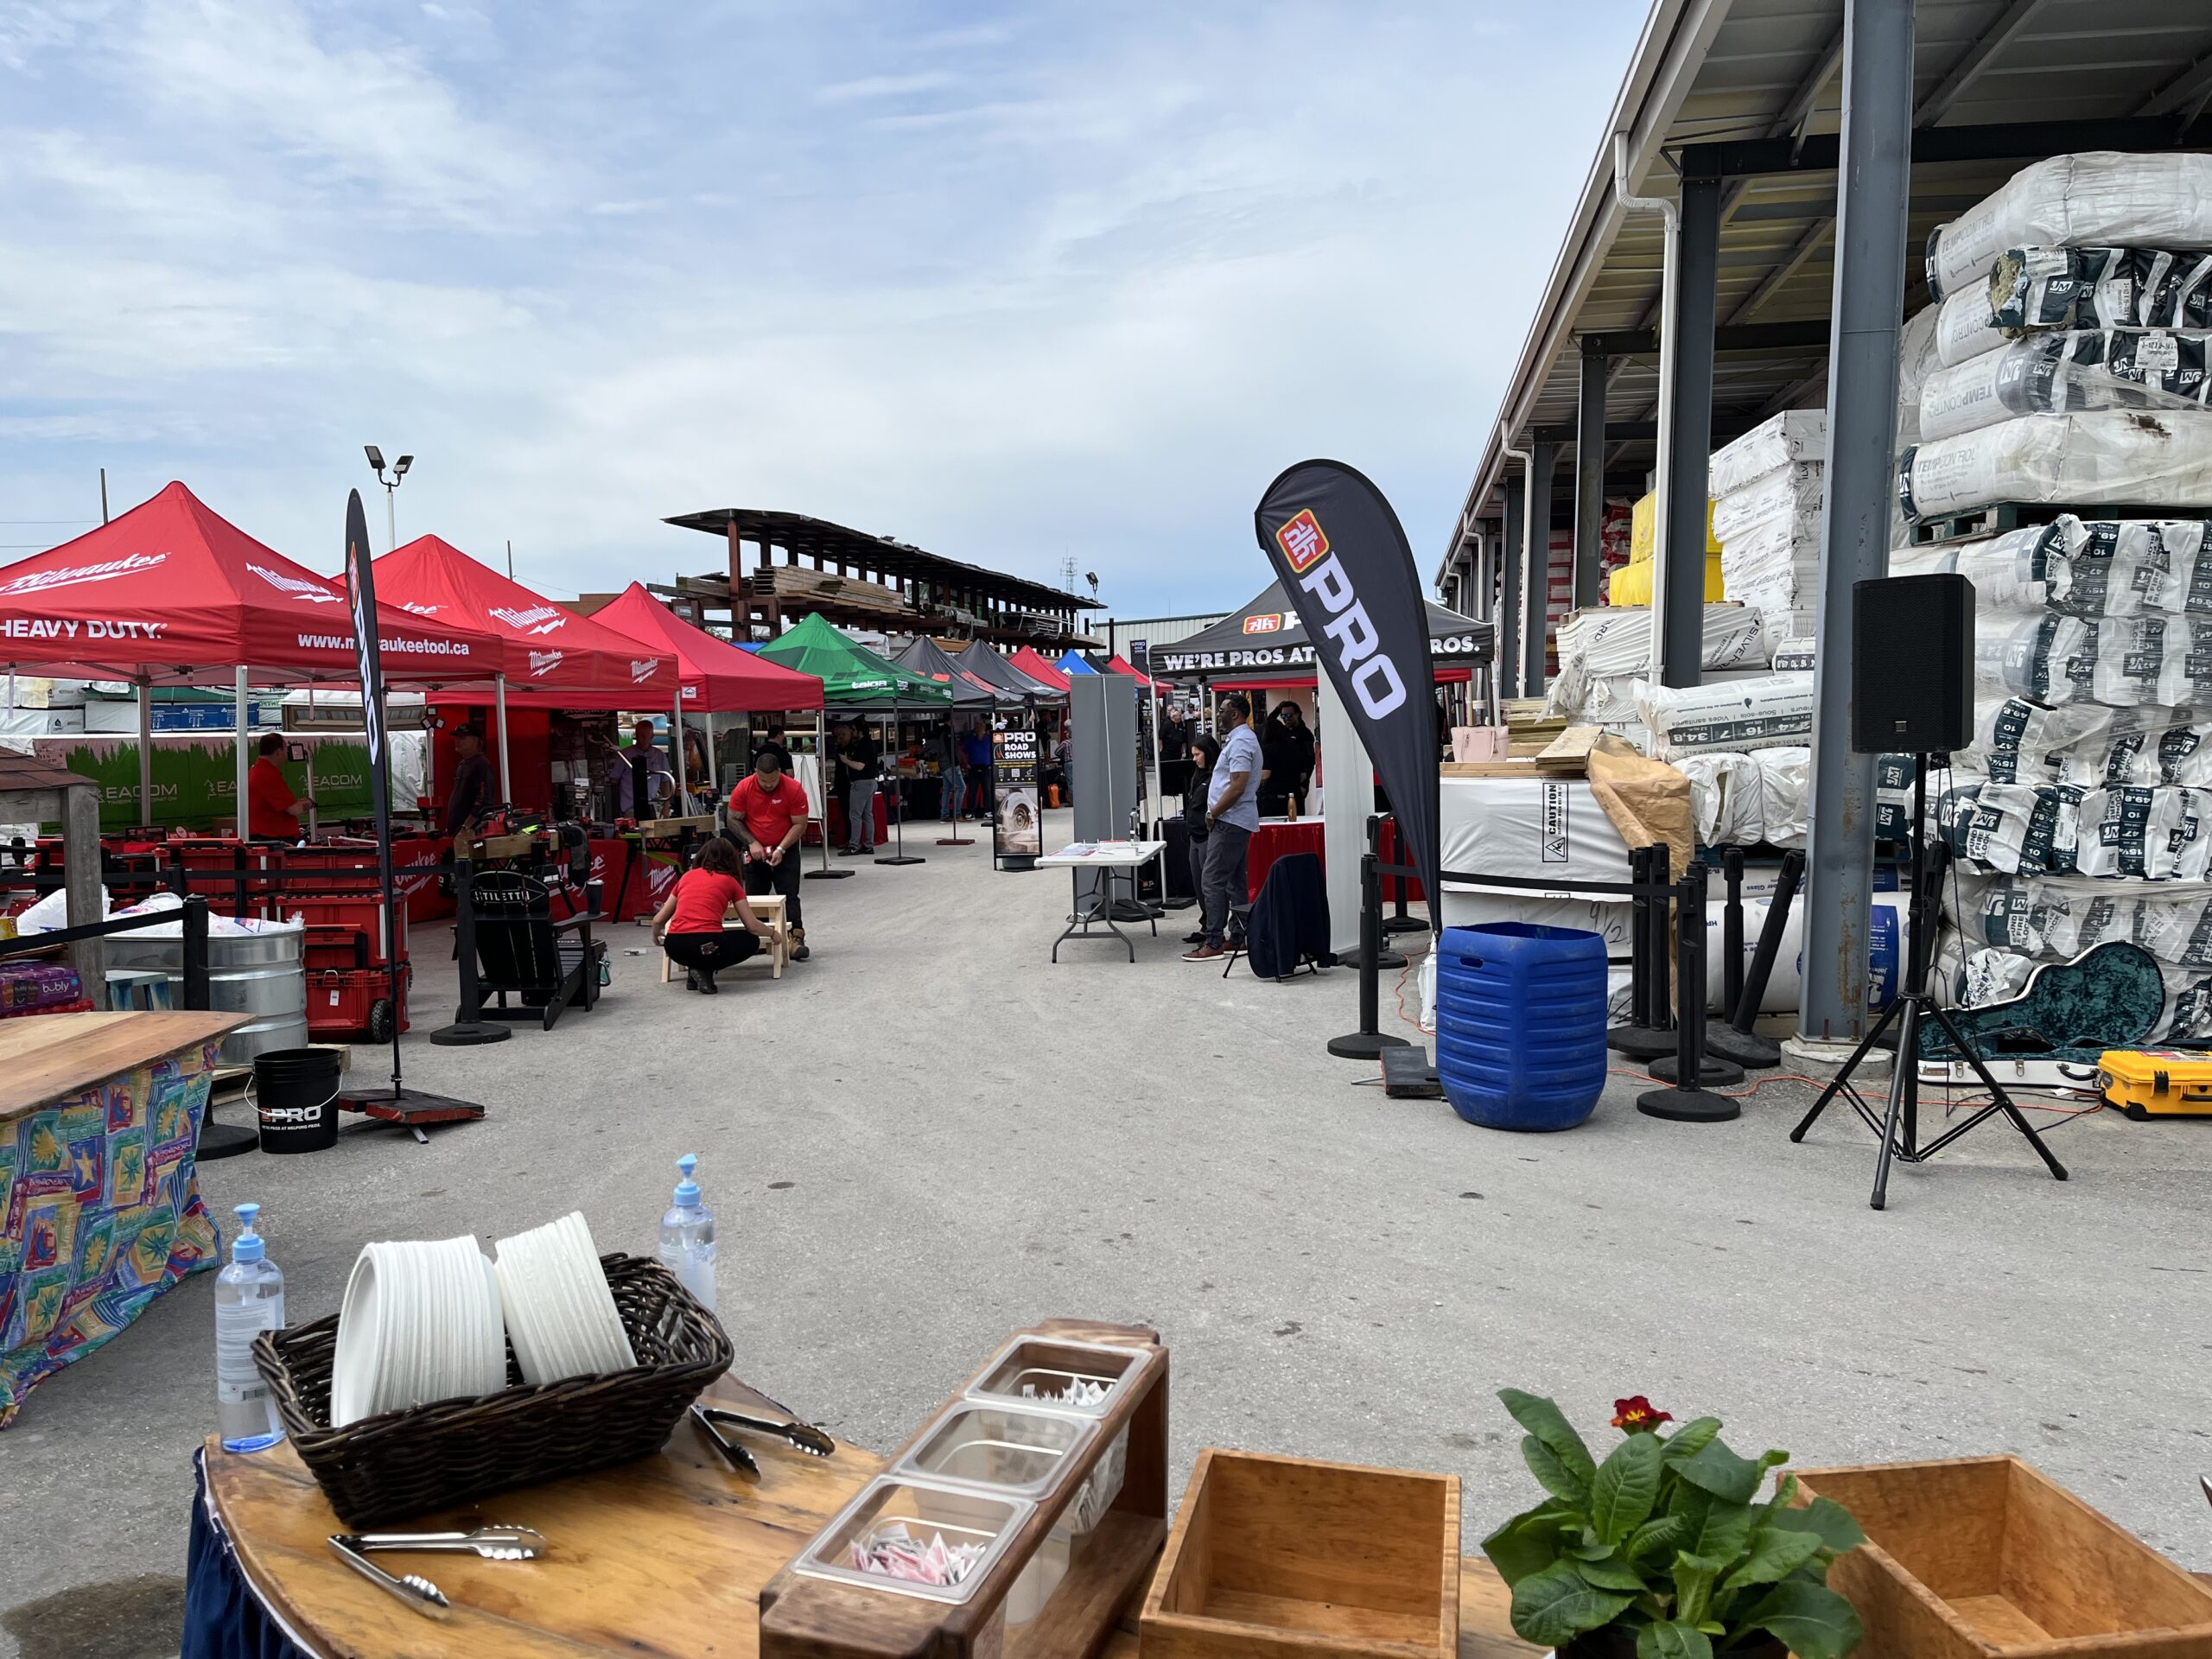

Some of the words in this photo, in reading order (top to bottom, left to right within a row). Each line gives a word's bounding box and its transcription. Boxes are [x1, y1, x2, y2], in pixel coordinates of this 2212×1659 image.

[1299, 550, 1407, 721] PRO
[298, 633, 470, 655] www.maukeetool.ca
[1230, 646, 1284, 668] PROS
[1288, 647, 1315, 664] AT
[1431, 635, 1480, 654] ROS.
[852, 680, 887, 690] taiga
[1004, 731, 1036, 742] PRO
[1004, 751, 1037, 760] SHOWS
[1548, 784, 1557, 836] CAUTION
[42, 980, 69, 994] bubly
[270, 1106, 321, 1122] PRO
